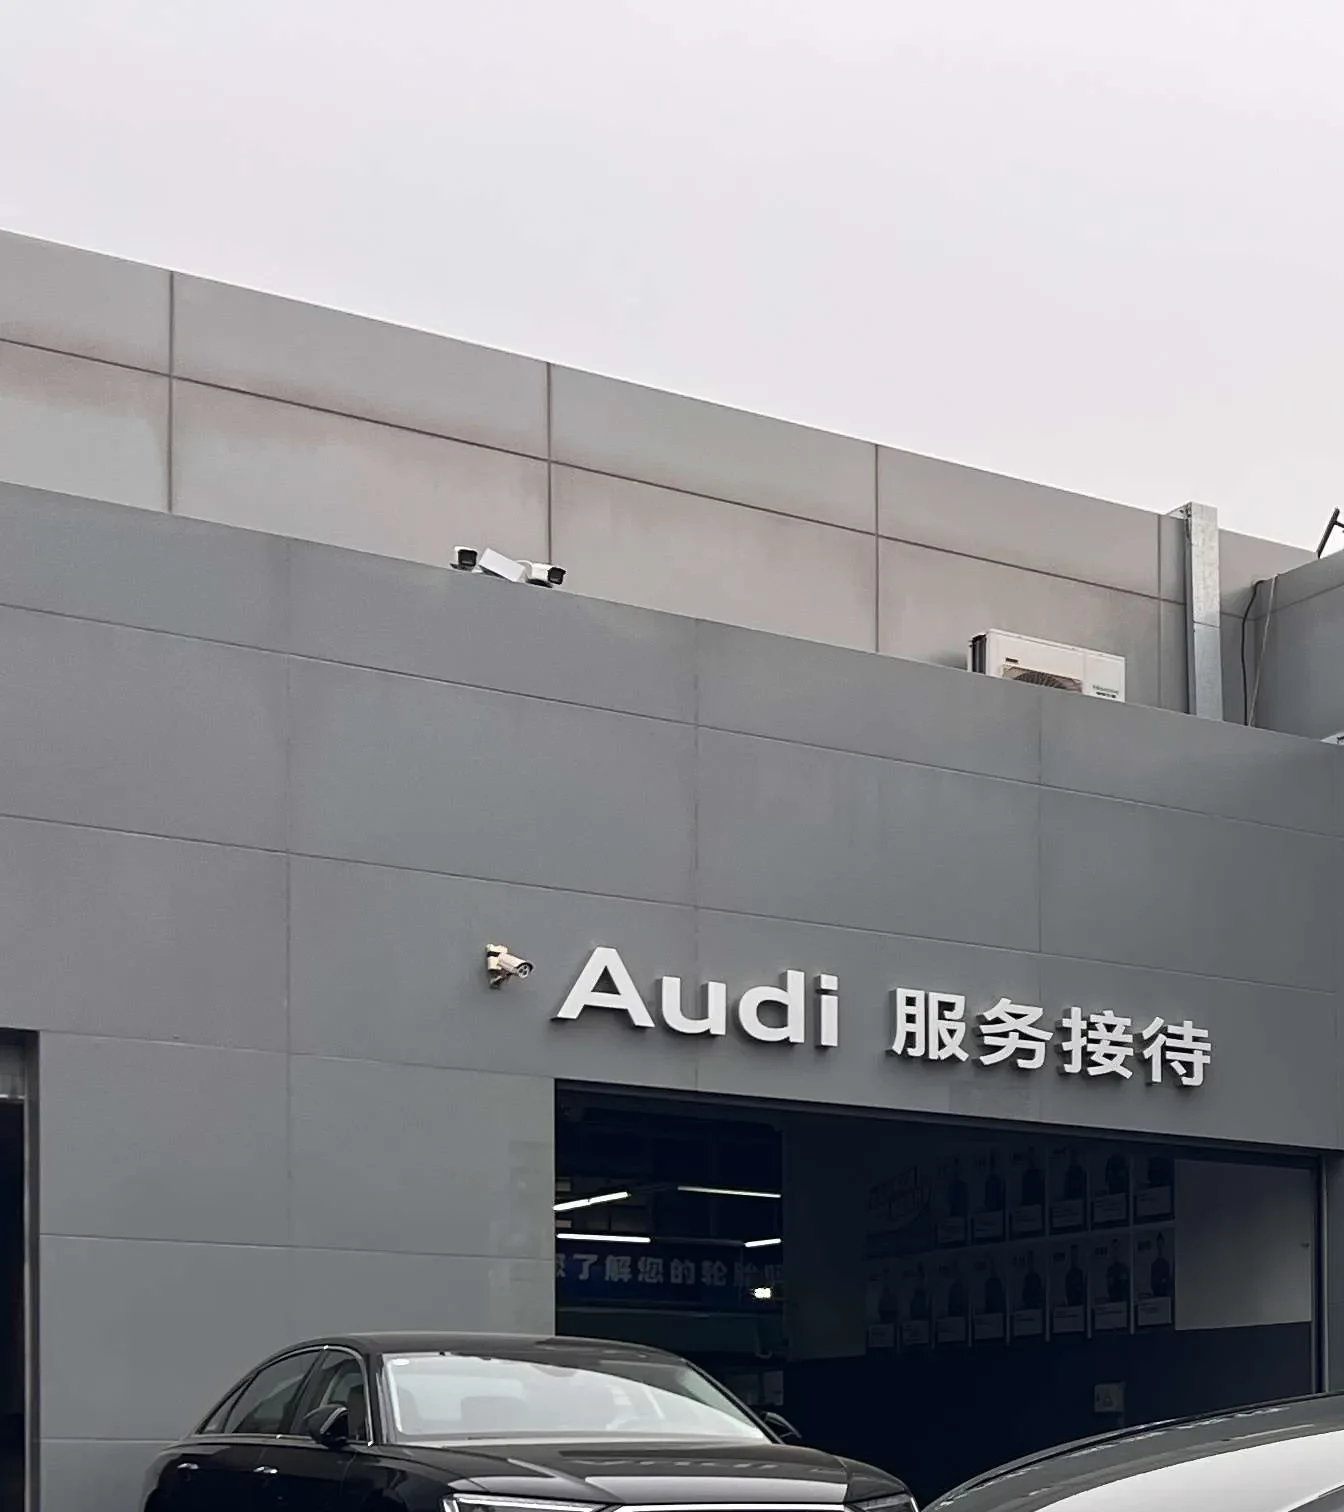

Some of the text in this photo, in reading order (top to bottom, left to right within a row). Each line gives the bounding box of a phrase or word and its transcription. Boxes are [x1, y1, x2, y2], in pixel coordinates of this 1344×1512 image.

[550, 945, 1212, 1087] Audi 服务接待
